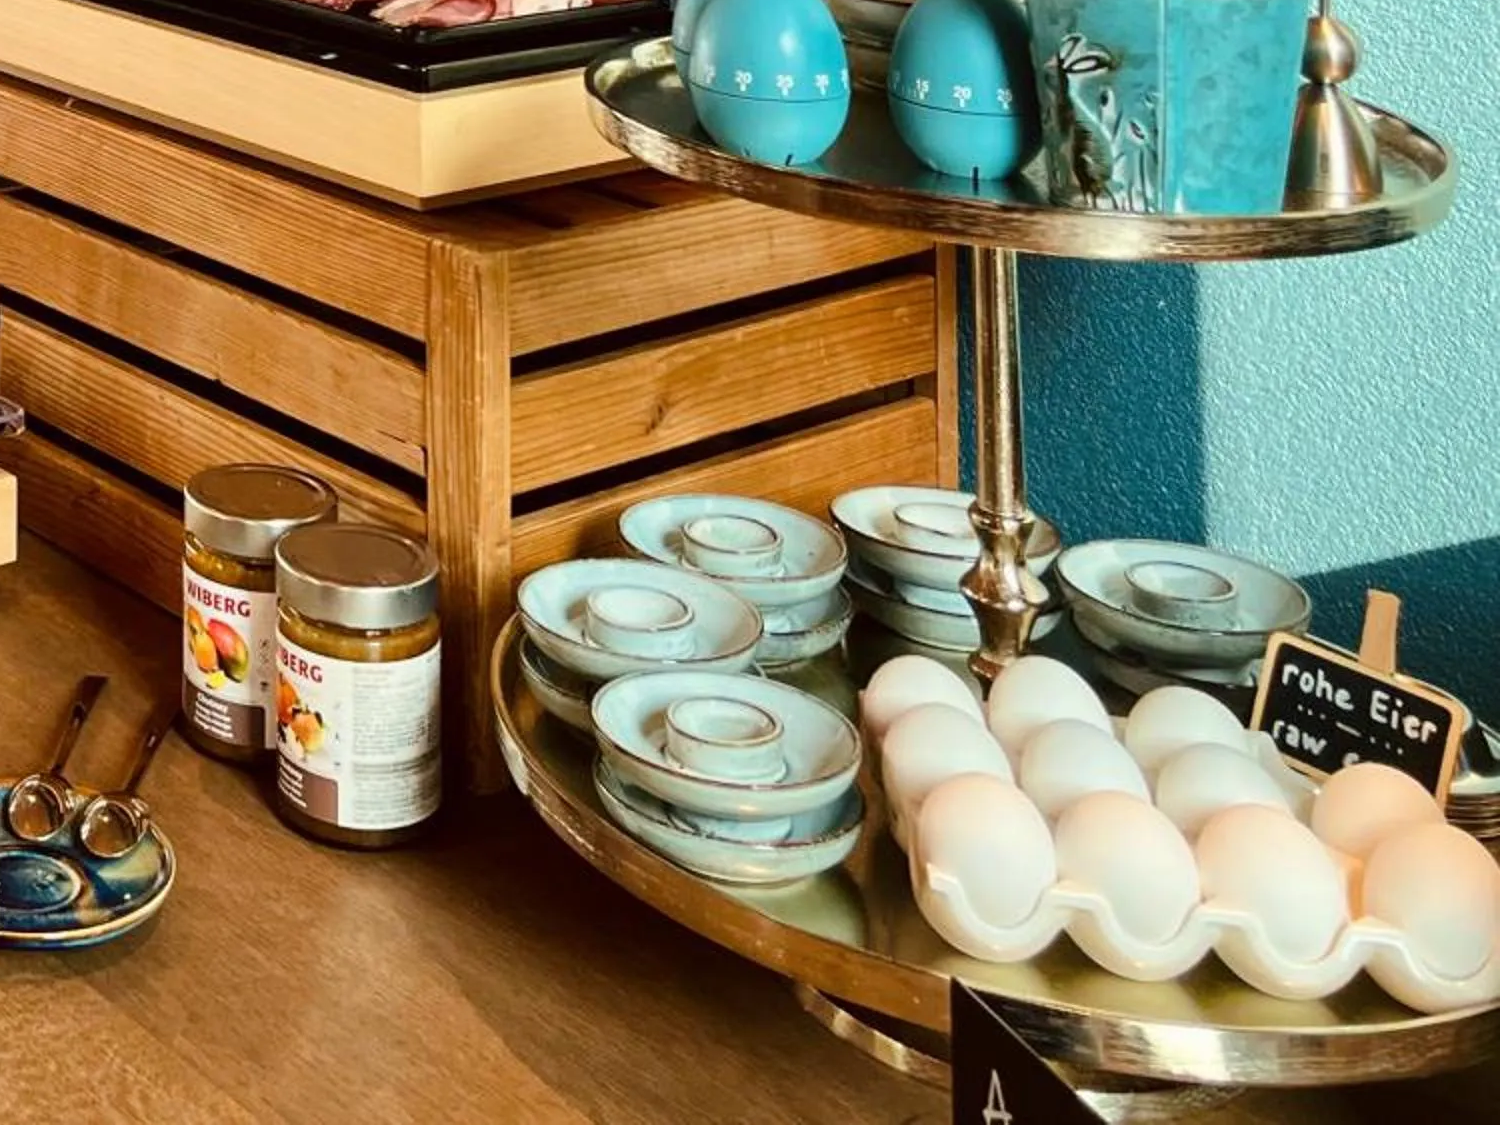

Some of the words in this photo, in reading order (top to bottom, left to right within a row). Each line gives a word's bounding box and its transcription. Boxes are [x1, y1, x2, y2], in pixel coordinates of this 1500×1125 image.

[1283, 664, 1354, 711] rohe
[1370, 690, 1438, 743] Eier
[1273, 720, 1328, 756] raw
